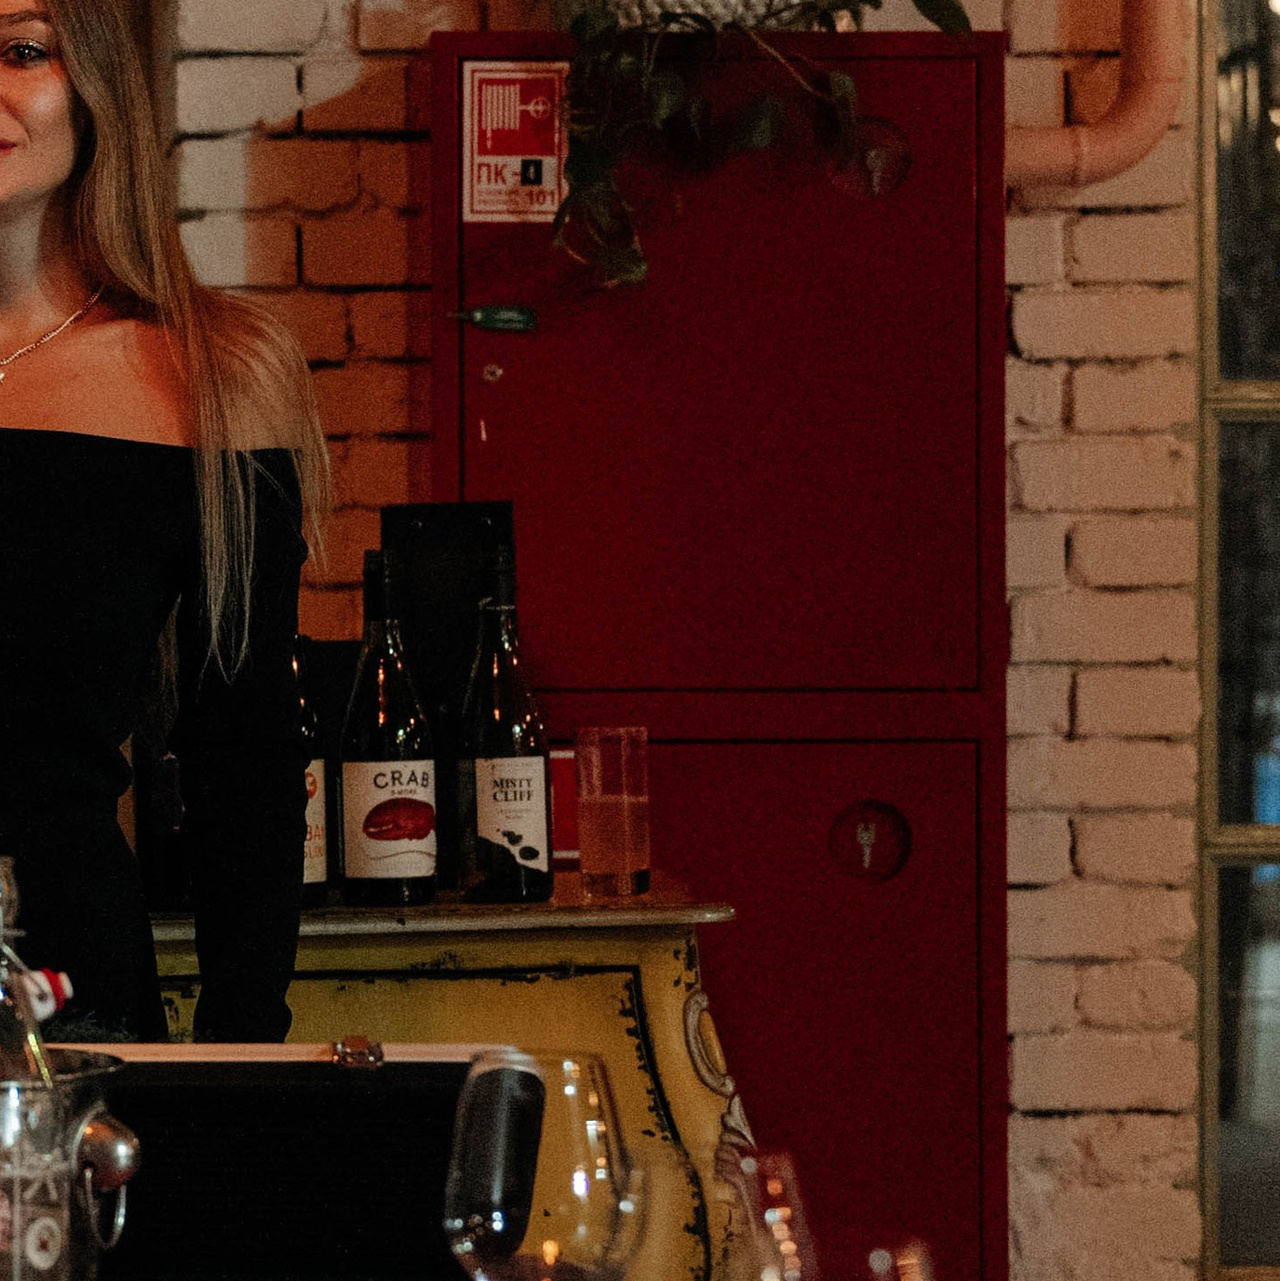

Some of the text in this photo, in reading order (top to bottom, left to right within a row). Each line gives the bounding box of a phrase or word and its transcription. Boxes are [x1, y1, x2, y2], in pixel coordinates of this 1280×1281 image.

[525, 189, 556, 206] 101
[373, 769, 430, 789] CRAB
[491, 777, 533, 789] MISTY
[492, 790, 534, 802] CLIFF
